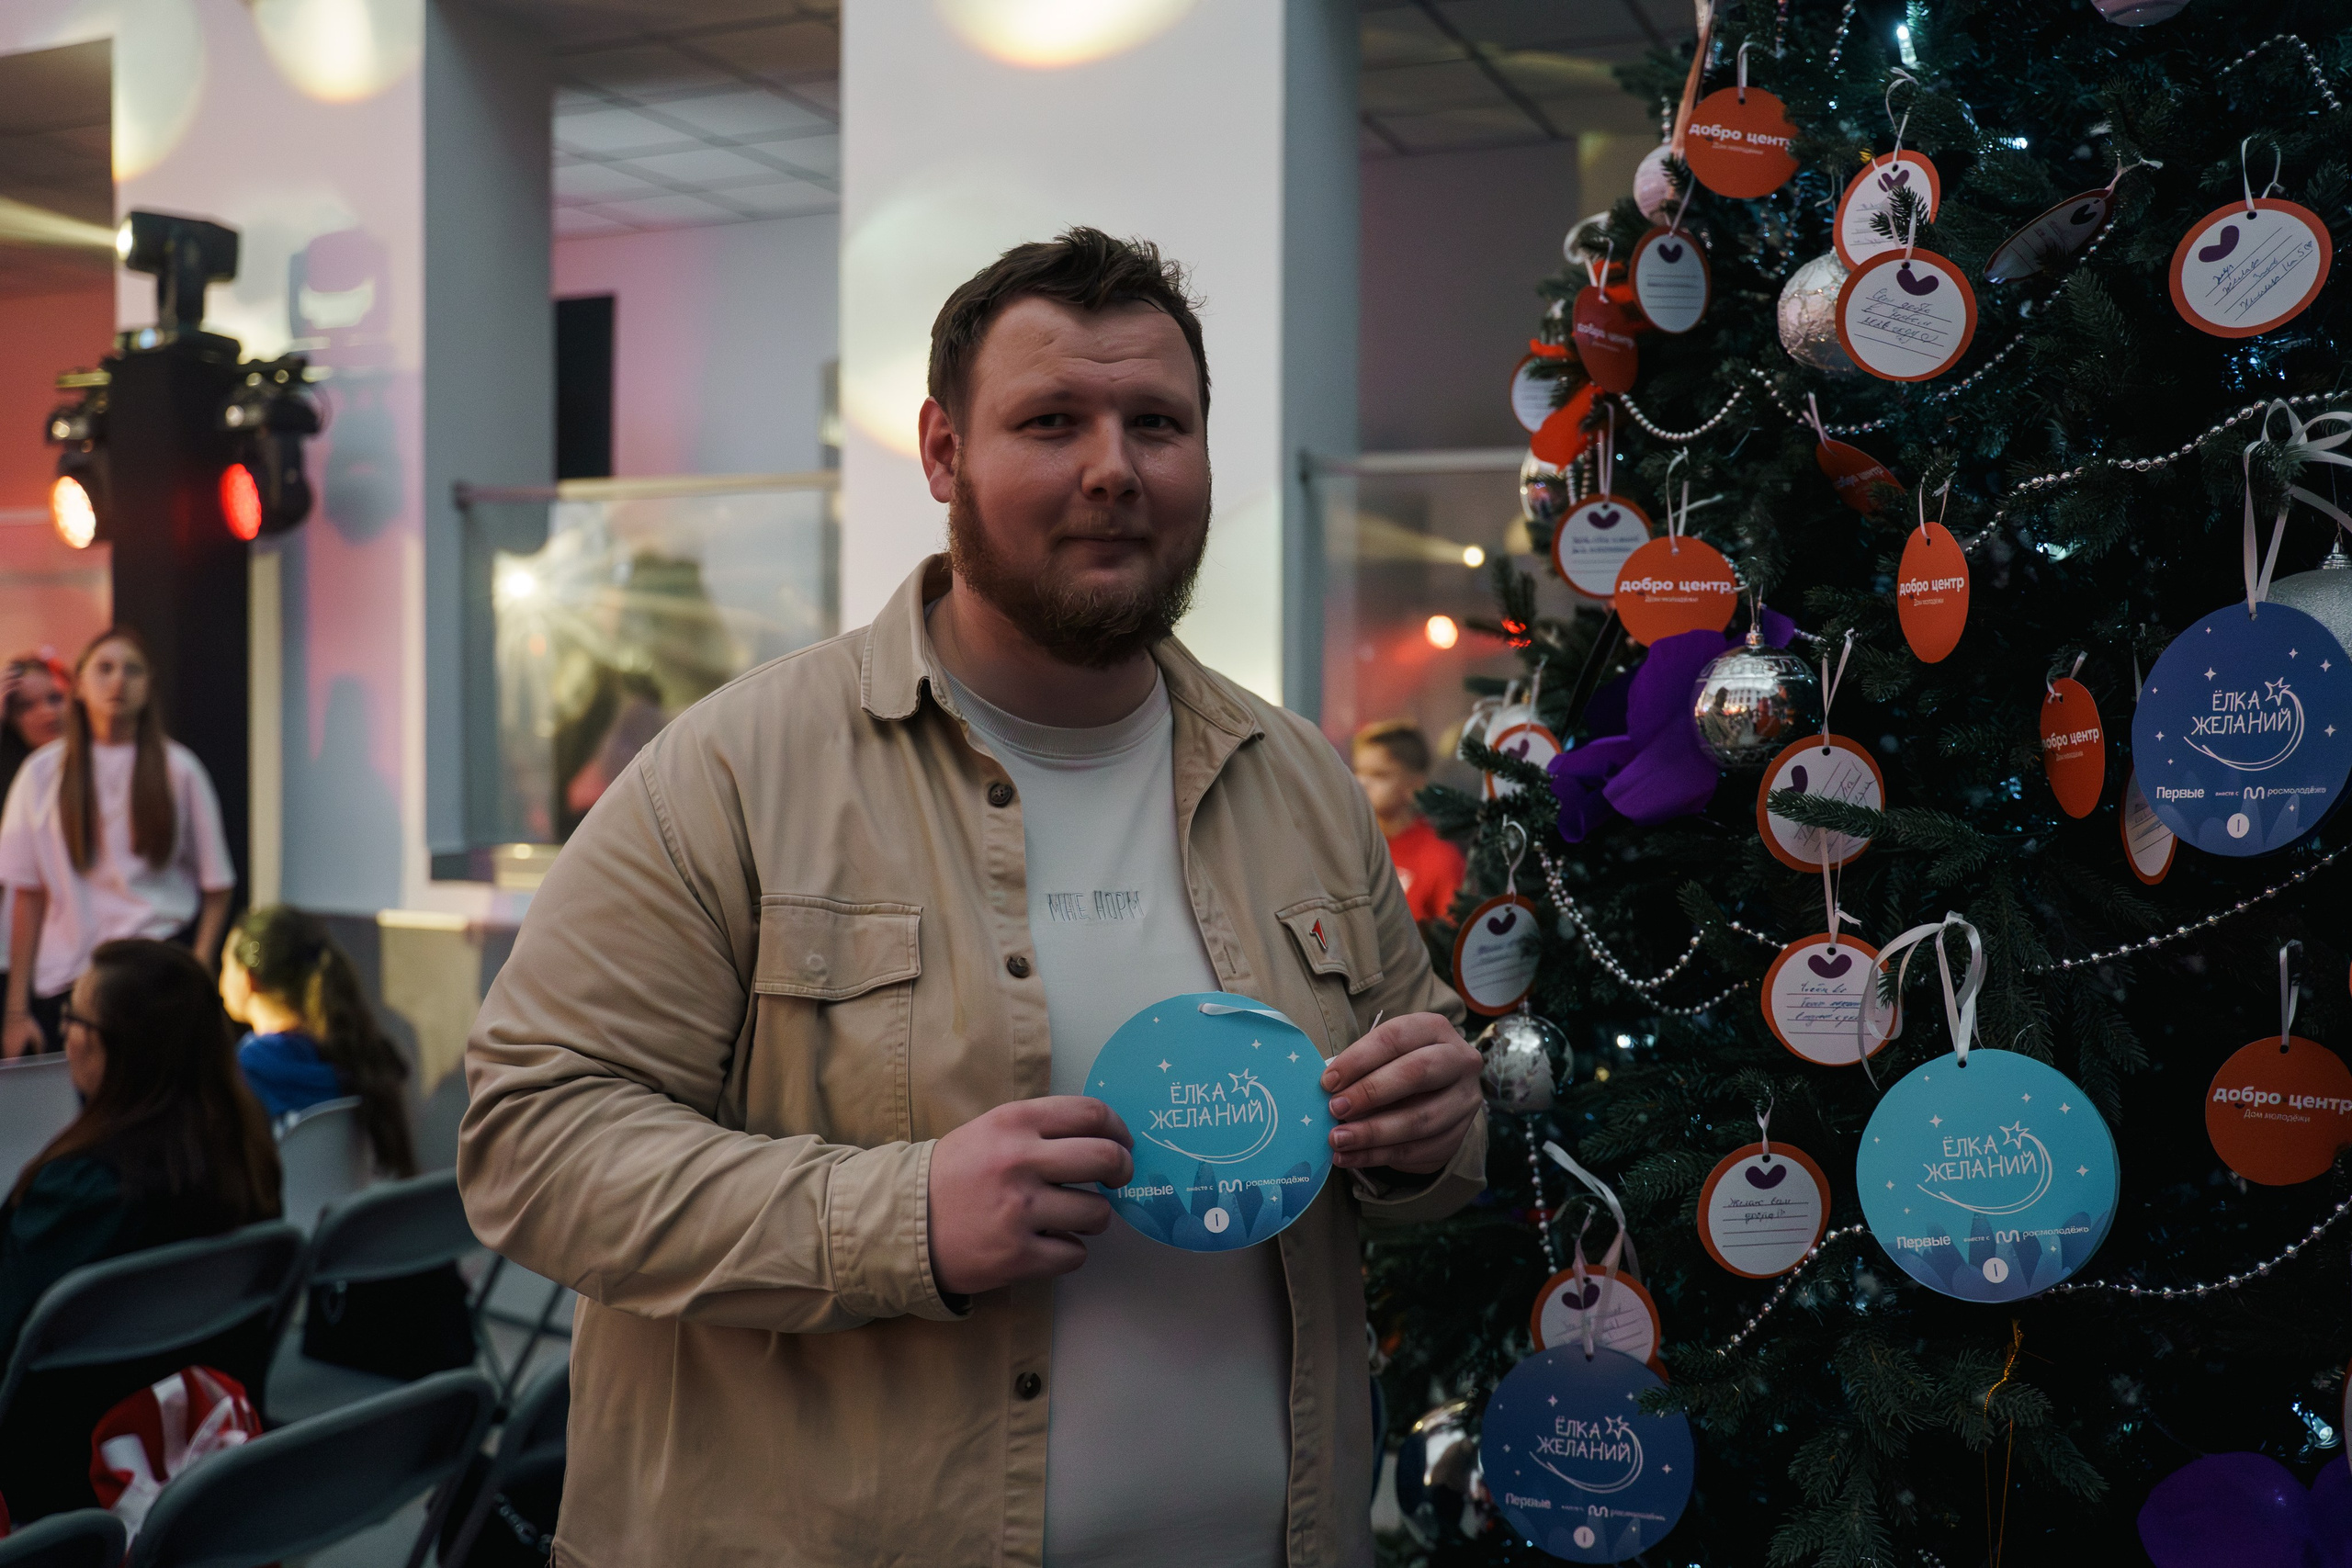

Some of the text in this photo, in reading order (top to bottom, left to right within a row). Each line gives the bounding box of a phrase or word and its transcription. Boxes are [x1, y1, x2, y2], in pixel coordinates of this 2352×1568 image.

[1689, 123, 1743, 141] добро
[1619, 576, 1733, 594] добро центр
[1899, 576, 1965, 597] добро центр
[2212, 690, 2261, 712] ЁЛКА
[2190, 707, 2292, 736] ЖЕЛАНИЙ
[2069, 728, 2100, 746] центр
[2155, 786, 2205, 803] Первые
[1046, 893, 1091, 921] МНЕ
[1170, 1081, 1227, 1105] ЁЛКА
[2212, 1086, 2352, 1115] добро центр
[1148, 1099, 1264, 1130] ЖЕЛАНИЙ
[2243, 1108, 2312, 1122] Дом молодёжи
[1942, 1134, 1999, 1157] ЁЛКА
[1922, 1150, 2038, 1183] ЖЕЛАНИЙ
[1117, 1184, 1174, 1201] Первые
[1245, 1175, 1310, 1190] росмолодёжь
[1896, 1235, 1951, 1252] Первые
[2022, 1225, 2089, 1240] росмолодёжь
[1555, 1416, 1600, 1439] ЁЛКА
[1535, 1434, 1631, 1463] ЖЕЛАНИЙ
